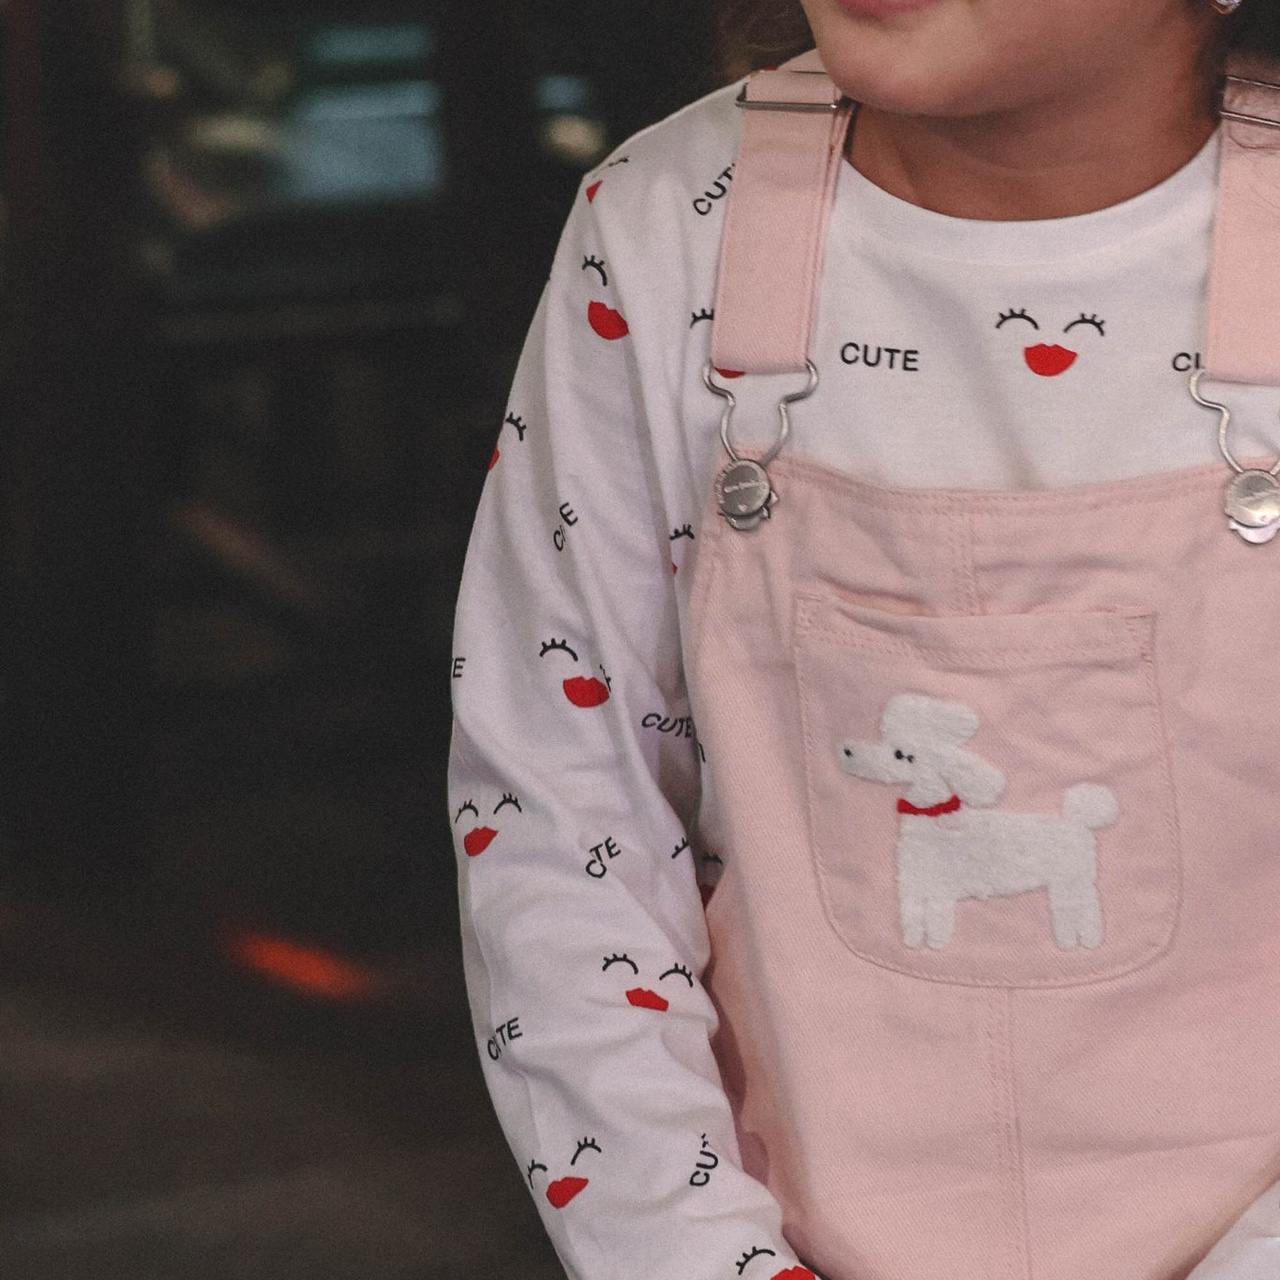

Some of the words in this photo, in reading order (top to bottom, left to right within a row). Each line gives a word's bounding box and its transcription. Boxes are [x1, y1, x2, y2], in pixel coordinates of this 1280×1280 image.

[692, 162, 736, 216] CUT
[841, 342, 919, 372] CUTE
[553, 501, 579, 552] CE
[585, 835, 622, 879] CTE
[689, 1132, 719, 1187] CU
